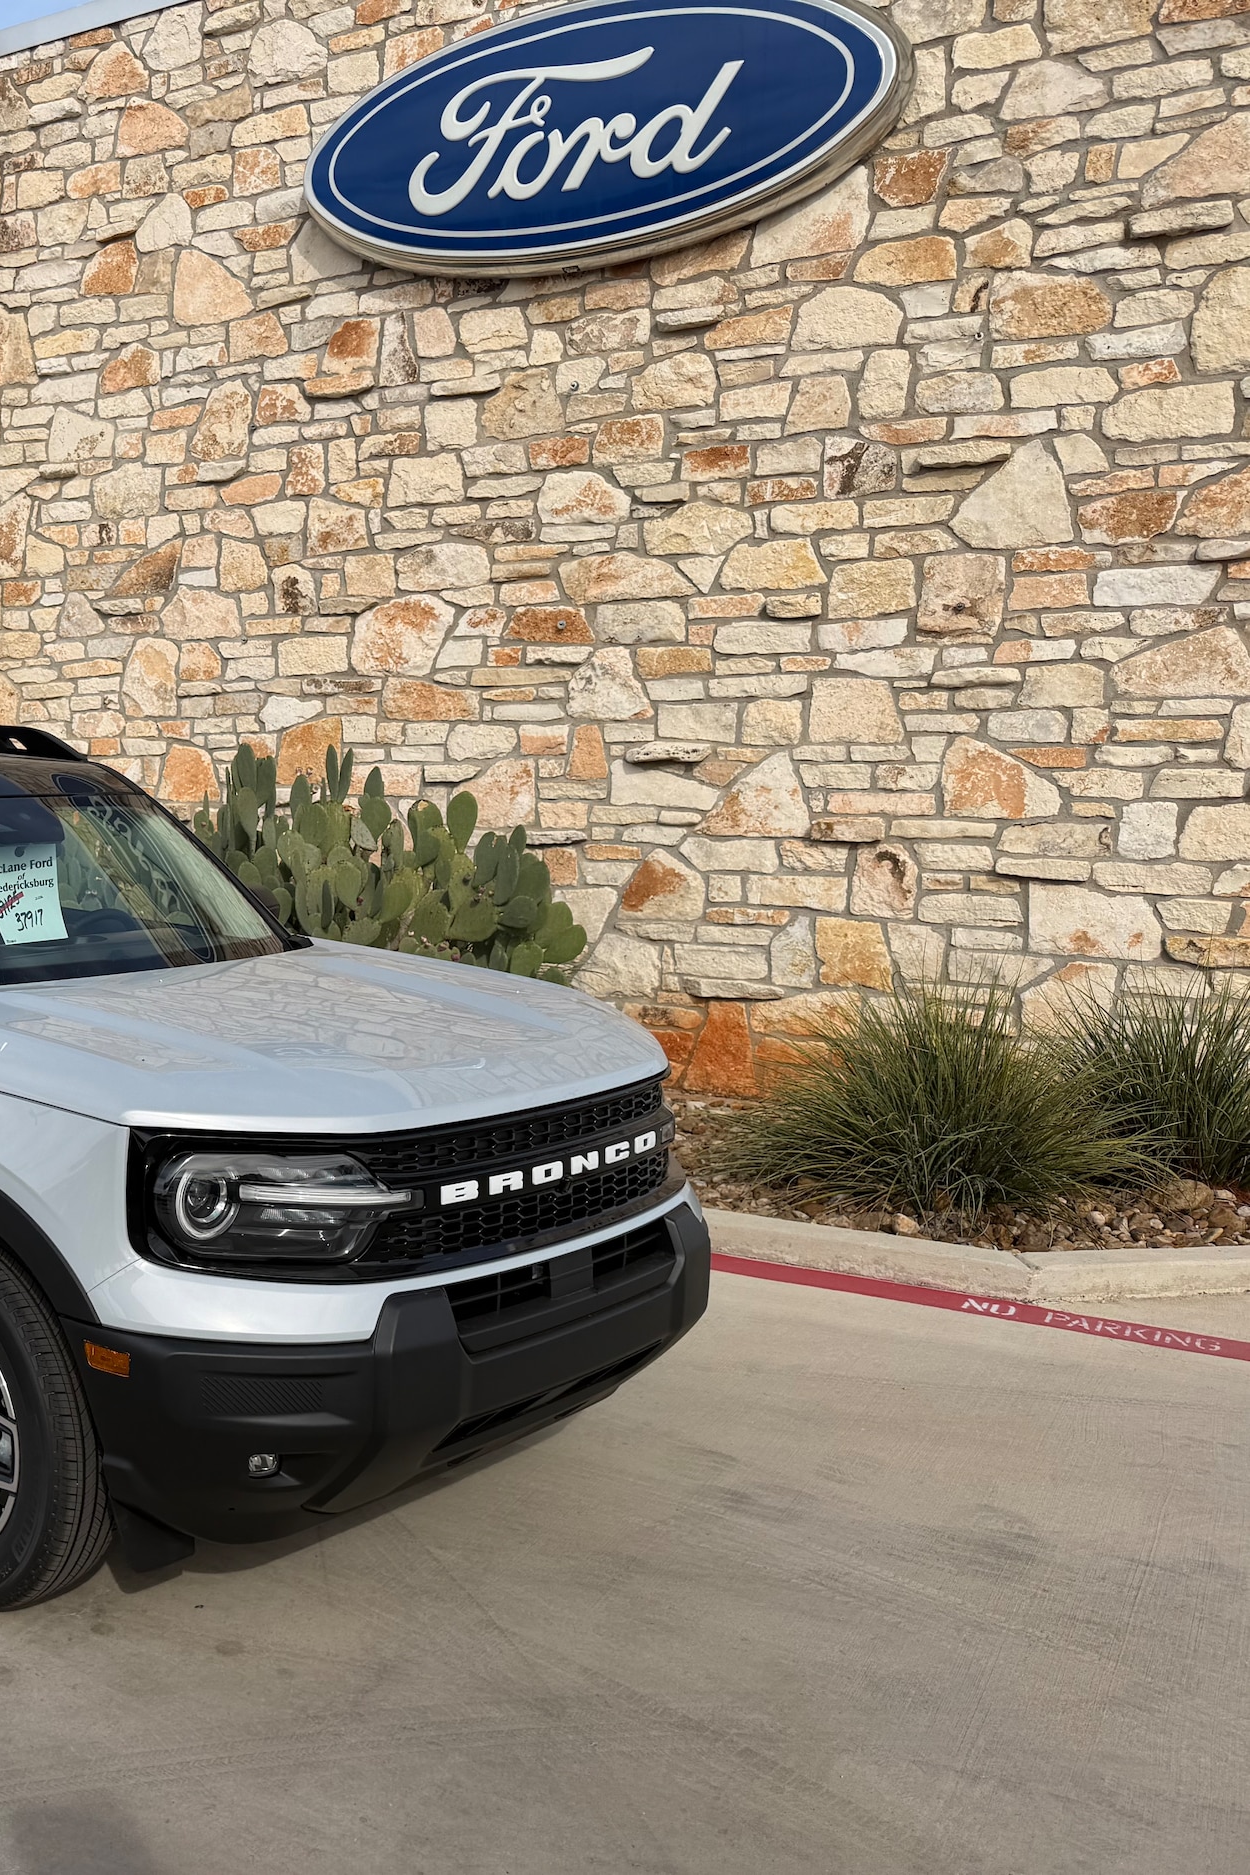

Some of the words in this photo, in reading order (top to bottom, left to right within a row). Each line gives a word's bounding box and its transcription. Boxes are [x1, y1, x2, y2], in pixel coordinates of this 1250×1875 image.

[407, 46, 745, 217] Ford
[17, 872, 26, 881] of
[30, 857, 53, 870] Ford
[15, 908, 43, 932] 37917
[440, 1130, 657, 1206] BRONCO
[961, 1298, 1016, 1317] NO
[1043, 1310, 1222, 1352] PARKING
